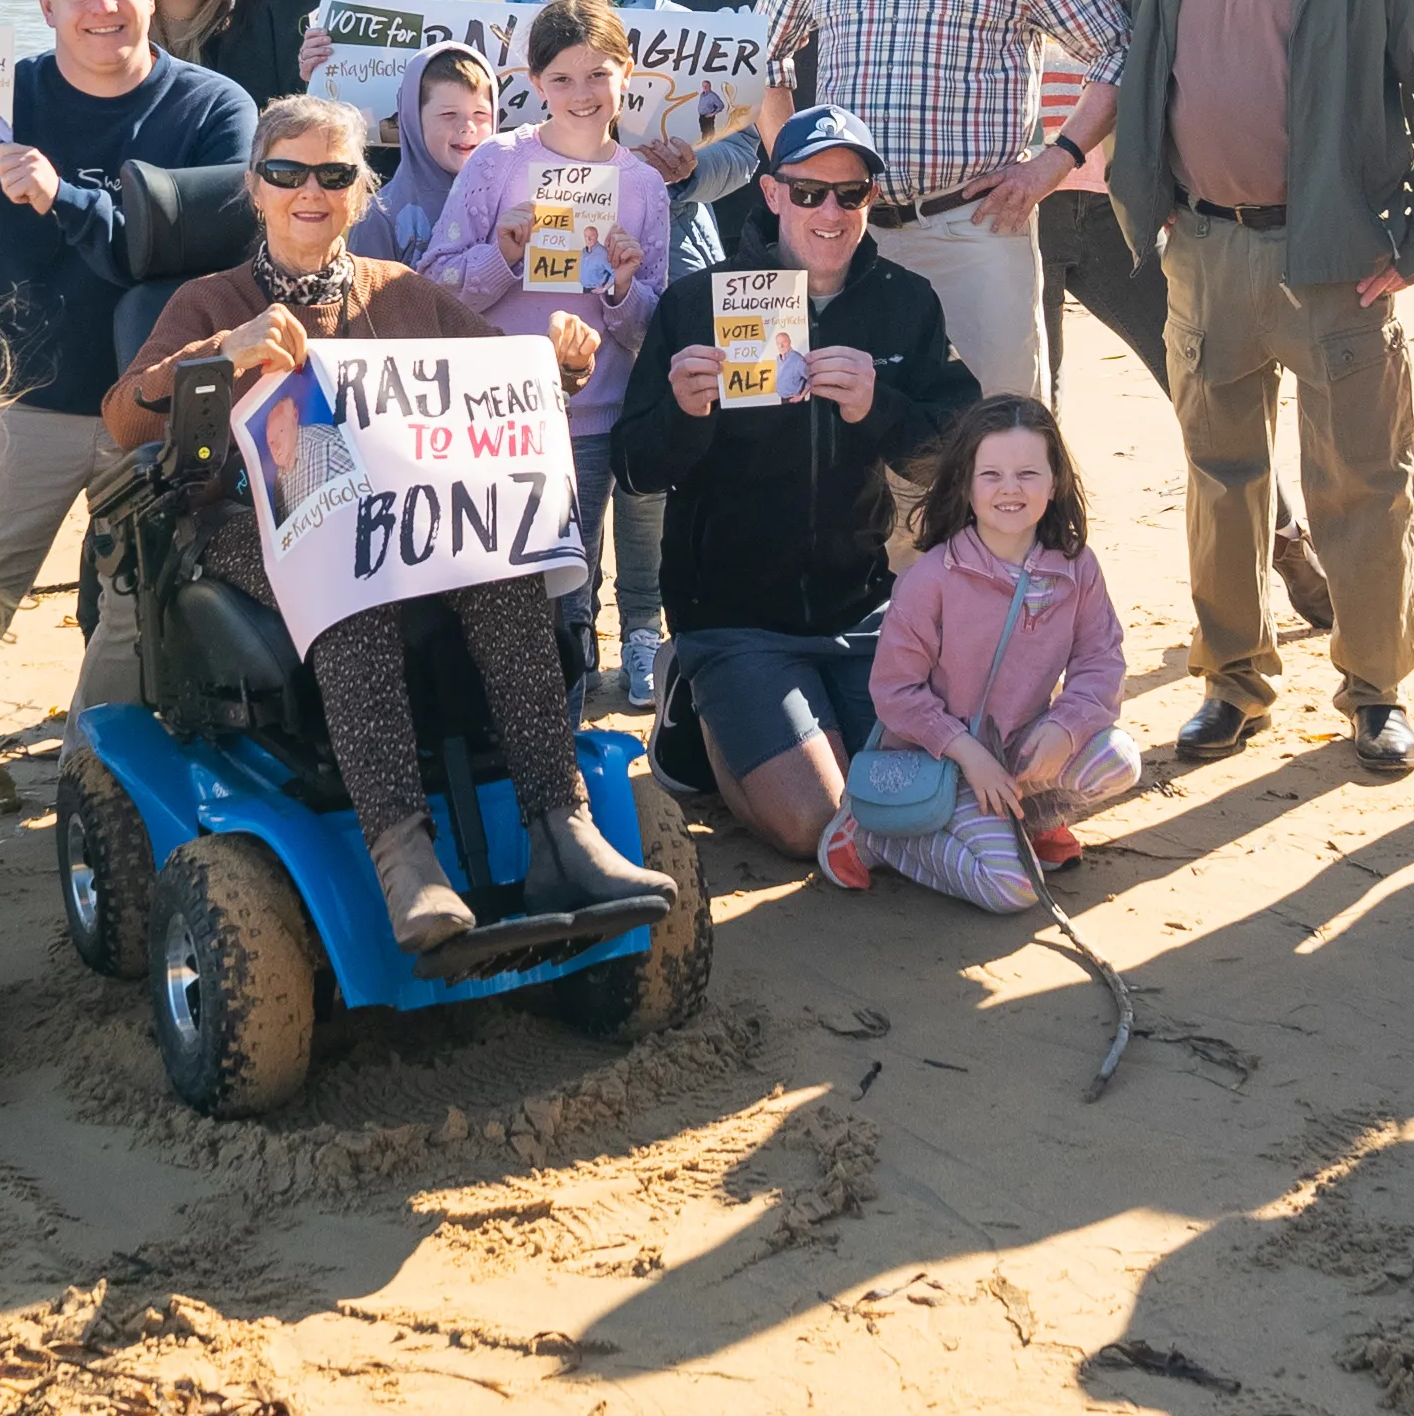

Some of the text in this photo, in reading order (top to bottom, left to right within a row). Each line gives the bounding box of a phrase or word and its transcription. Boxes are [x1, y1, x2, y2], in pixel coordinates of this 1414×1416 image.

[328, 9, 418, 48] VOTE for
[541, 167, 592, 187] STOP
[536, 187, 612, 206] BLUDGING!
[534, 214, 569, 227] VOTE
[543, 234, 566, 247] FOR
[533, 256, 577, 279] ALF
[726, 272, 778, 296] STOP
[722, 296, 801, 311] BLUDGING!
[722, 324, 760, 339] VOTE
[734, 346, 759, 359] FOR
[728, 369, 772, 393] ALF
[332, 355, 451, 430] RAY
[408, 422, 453, 460] TO
[280, 474, 375, 552] #Ray4Gold
